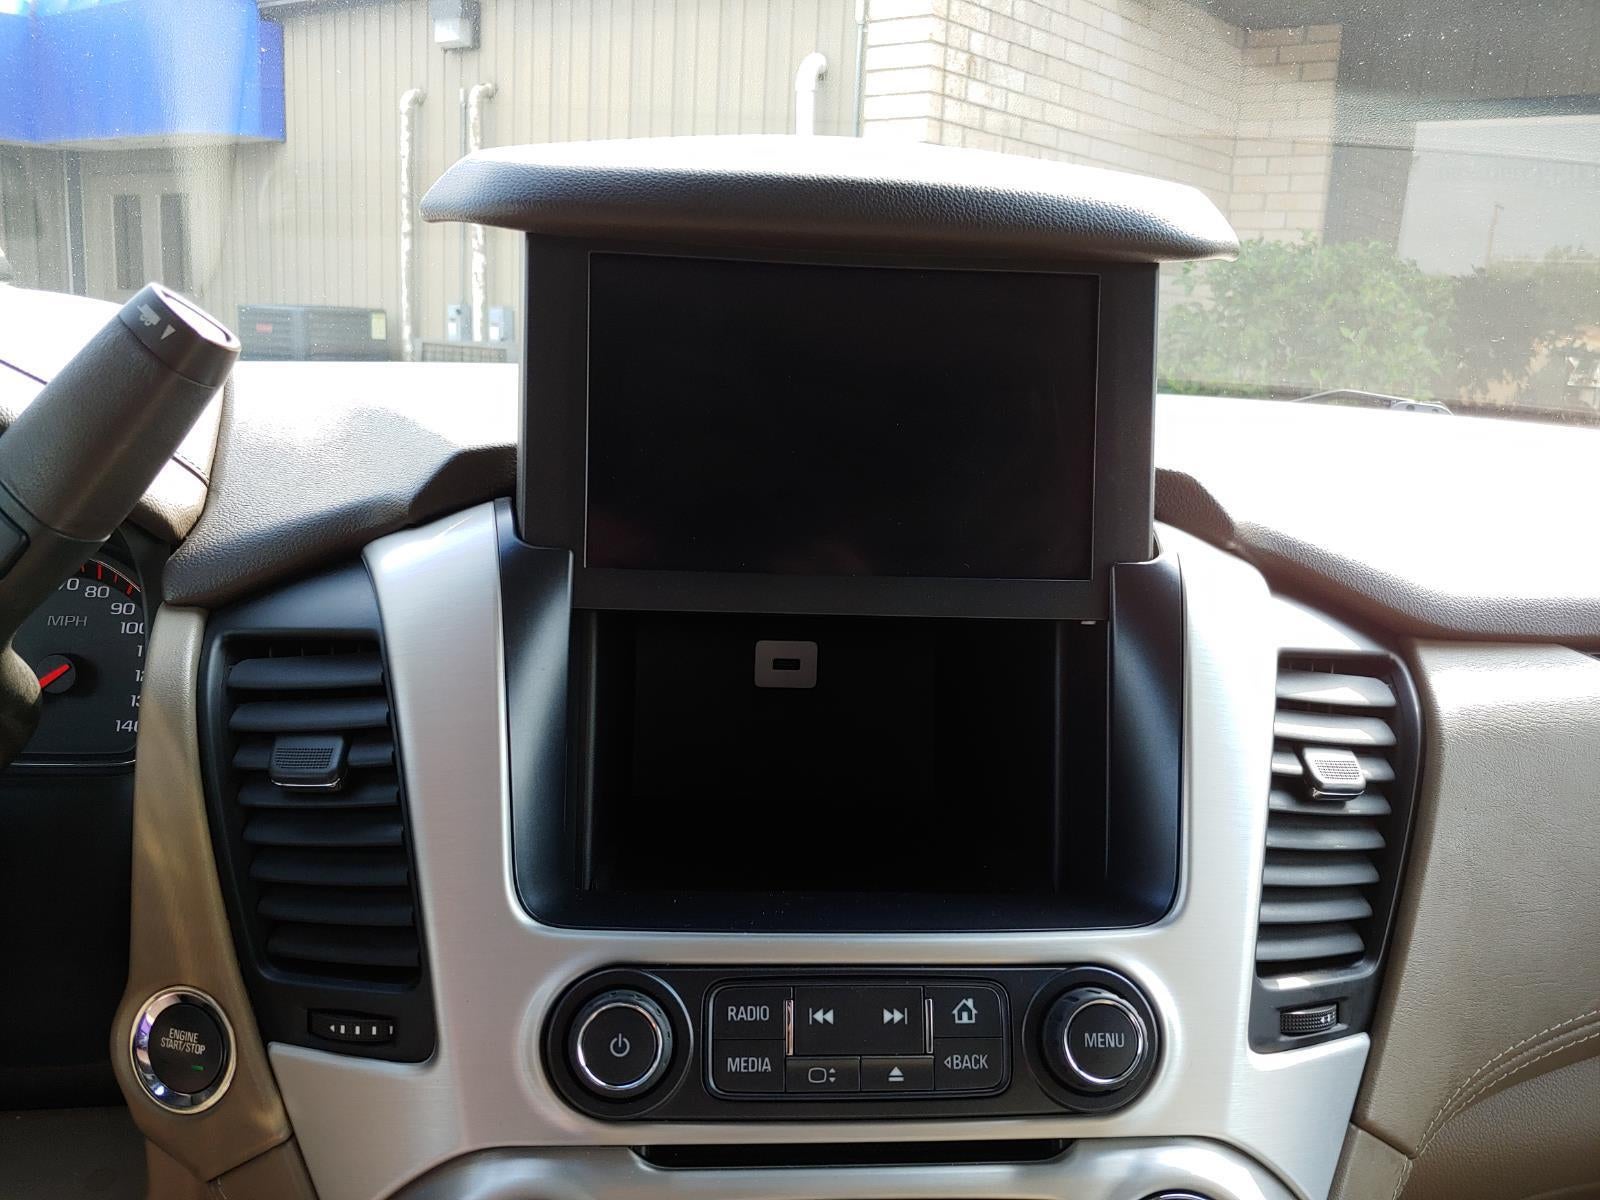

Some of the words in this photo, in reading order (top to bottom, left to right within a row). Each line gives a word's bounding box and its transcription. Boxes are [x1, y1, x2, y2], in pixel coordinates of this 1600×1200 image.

[84, 585, 110, 598] 80
[110, 602, 136, 615] 90
[47, 615, 88, 627] MPH
[115, 719, 138, 733] 14
[727, 1005, 770, 1022] RADIO
[169, 1027, 199, 1044] ENGINE
[1084, 1032, 1125, 1048] MENU
[160, 1036, 206, 1056] START/STOP
[727, 1056, 772, 1073] MEDIA
[952, 1054, 989, 1070] BACK
